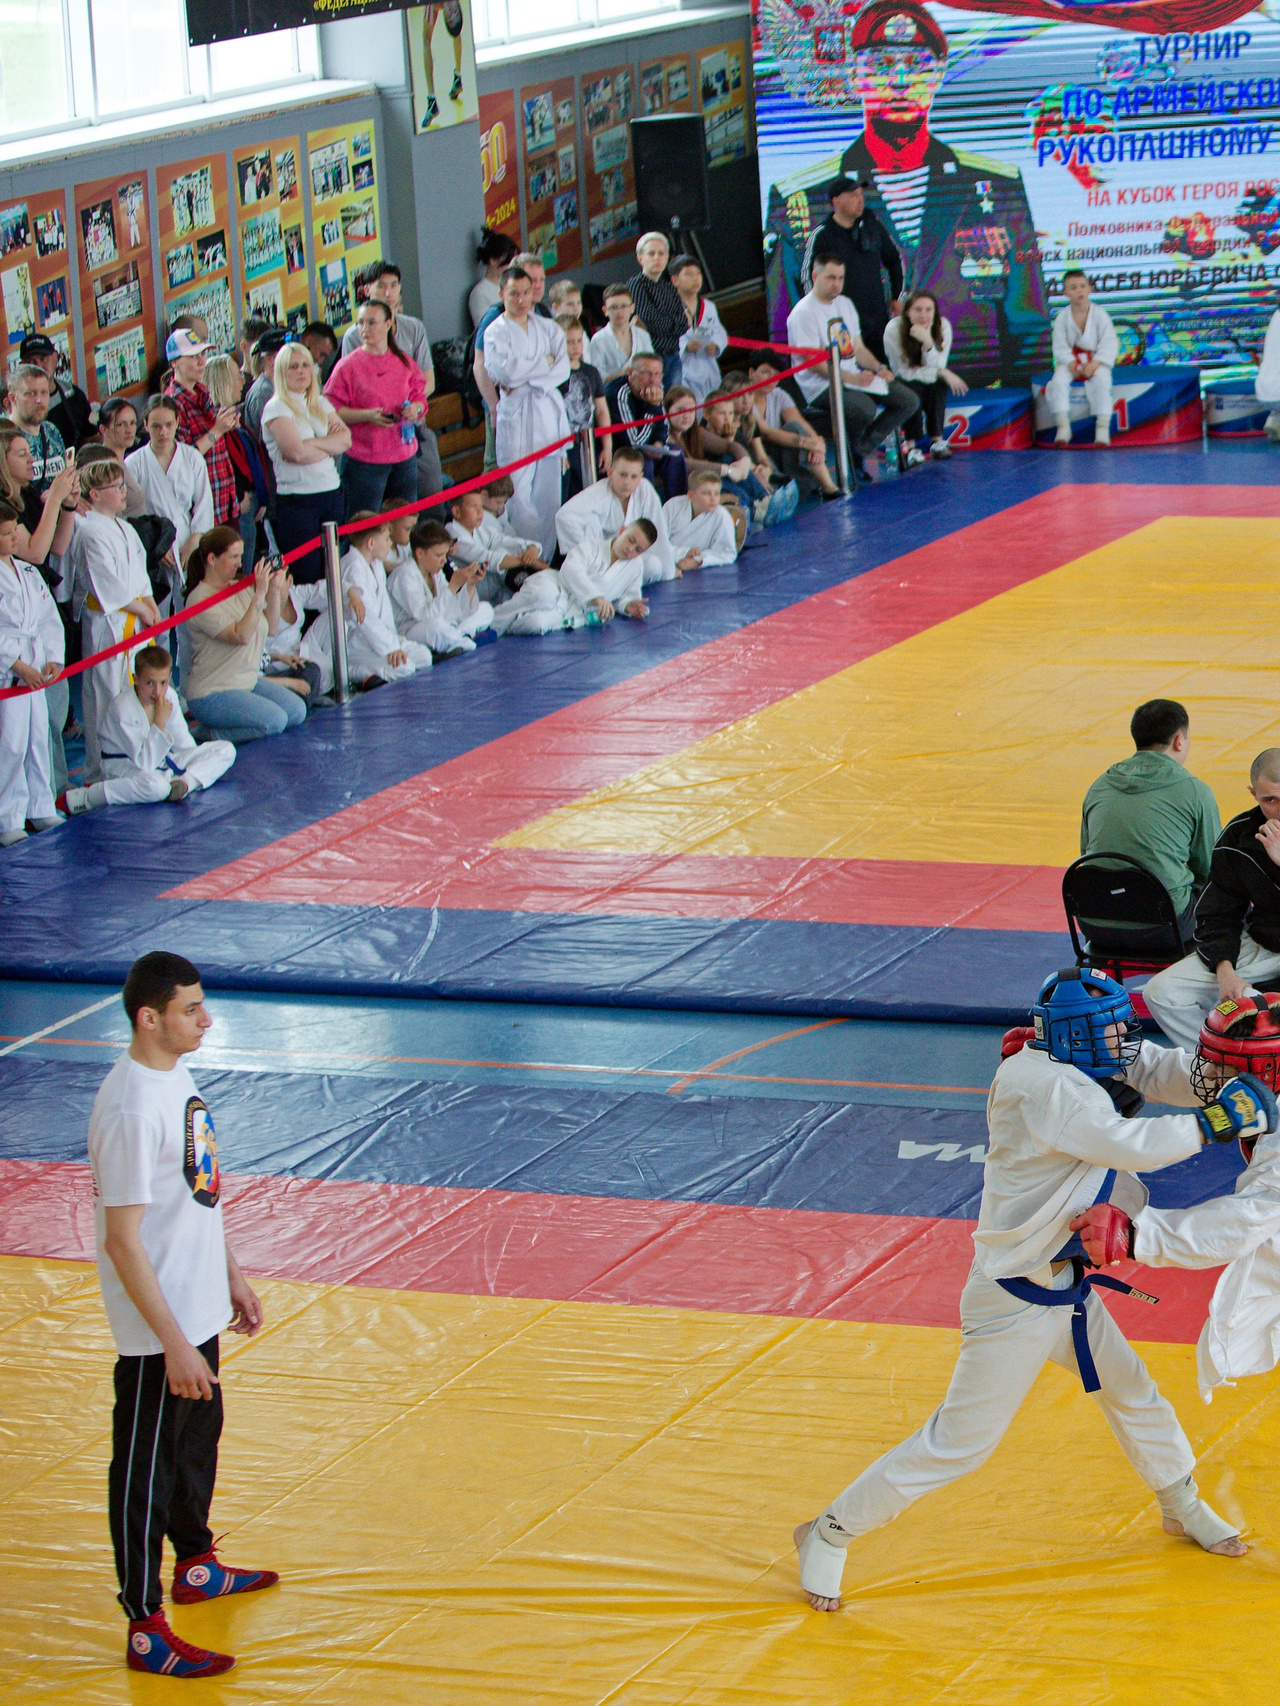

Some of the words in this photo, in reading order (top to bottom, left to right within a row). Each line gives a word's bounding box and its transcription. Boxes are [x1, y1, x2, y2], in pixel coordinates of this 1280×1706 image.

[1134, 31, 1251, 65] ТУРНИР
[1063, 88, 1103, 118] ПО
[1037, 124, 1275, 167] РУКОПАШНОМУ
[1087, 189, 1111, 207] НА
[1117, 185, 1176, 205] КУБОК
[1182, 181, 1239, 201] ГЕРОЯ
[1067, 219, 1163, 237] Полковника
[1066, 237, 1181, 262] национальной
[1150, 263, 1267, 289] ЮРЬЕВИЧА
[1113, 397, 1129, 430] 1
[948, 414, 971, 446] 2
